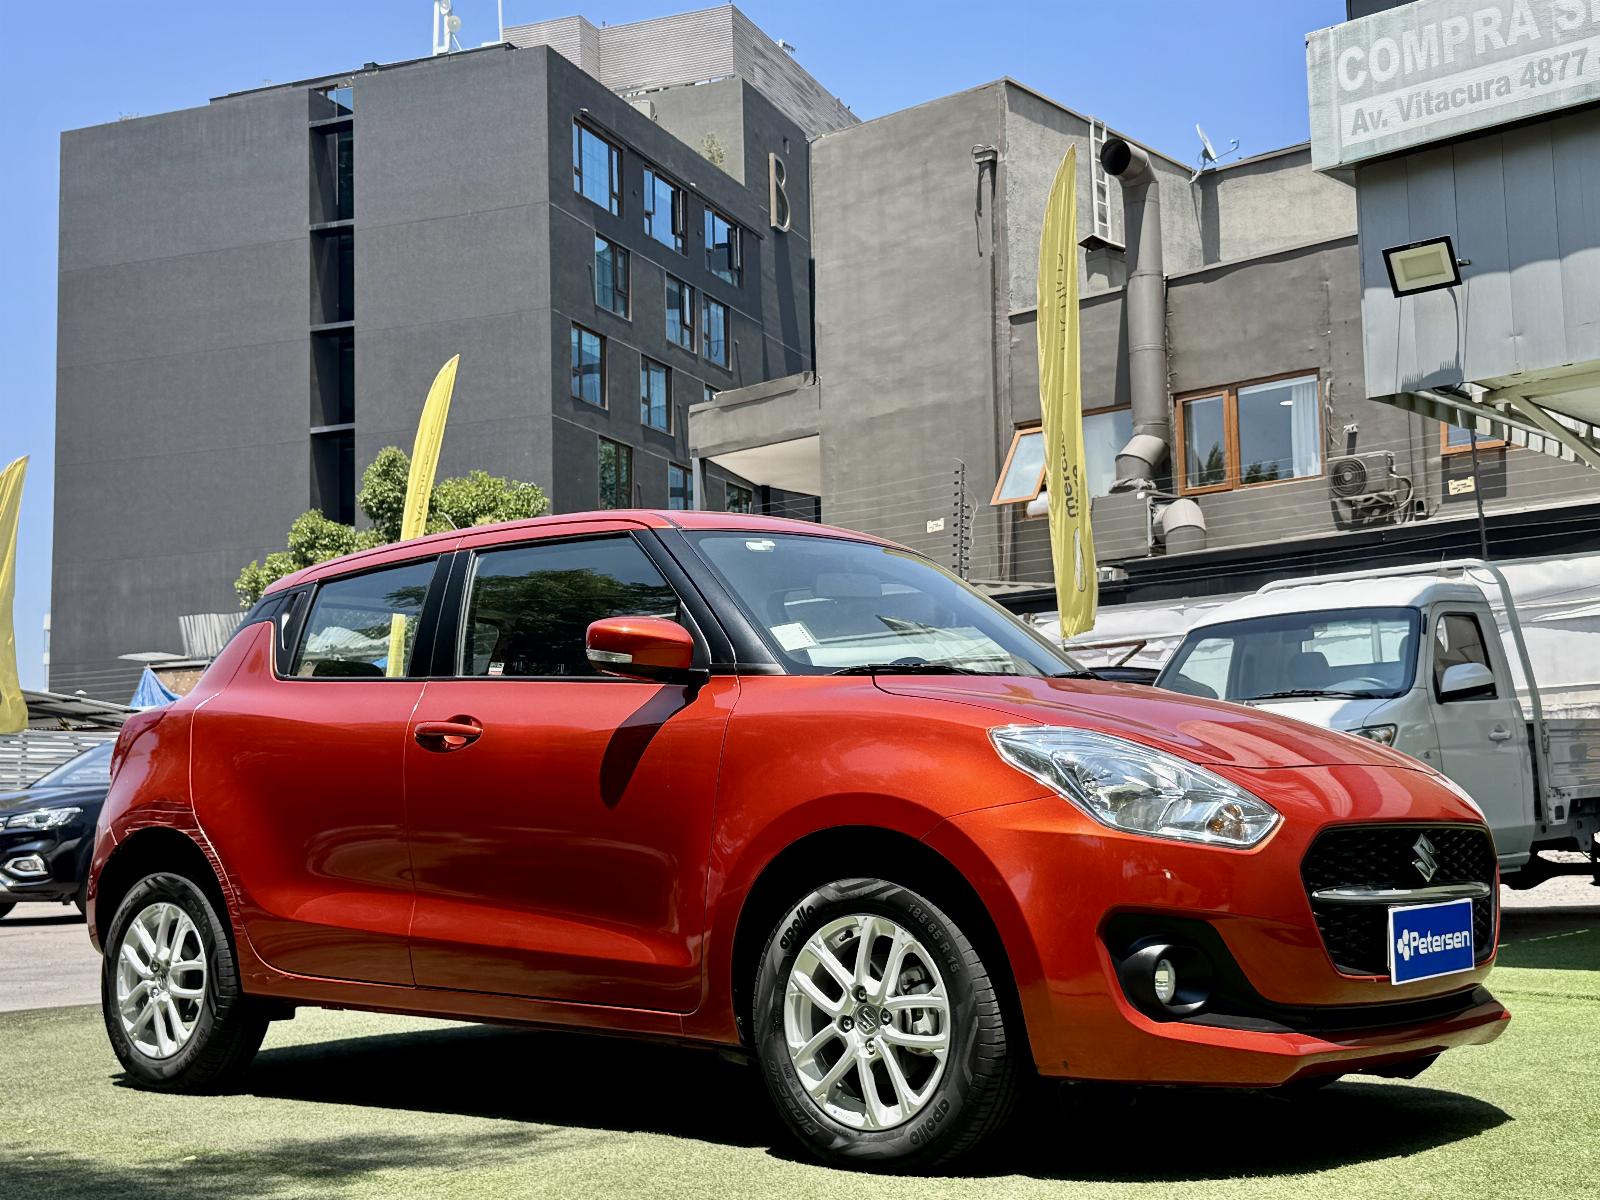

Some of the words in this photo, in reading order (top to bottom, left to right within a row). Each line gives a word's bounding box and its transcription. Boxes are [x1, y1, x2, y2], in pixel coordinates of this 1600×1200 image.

[1337, 0, 1541, 91] COMPRA
[1554, 0, 1600, 31] S
[1351, 107, 1388, 136] Av.
[1396, 76, 1511, 122] Vitacura
[1519, 48, 1589, 88] 4877
[780, 904, 816, 950] apollo
[1410, 929, 1470, 956] Petersen
[910, 1098, 950, 1145] apollo
